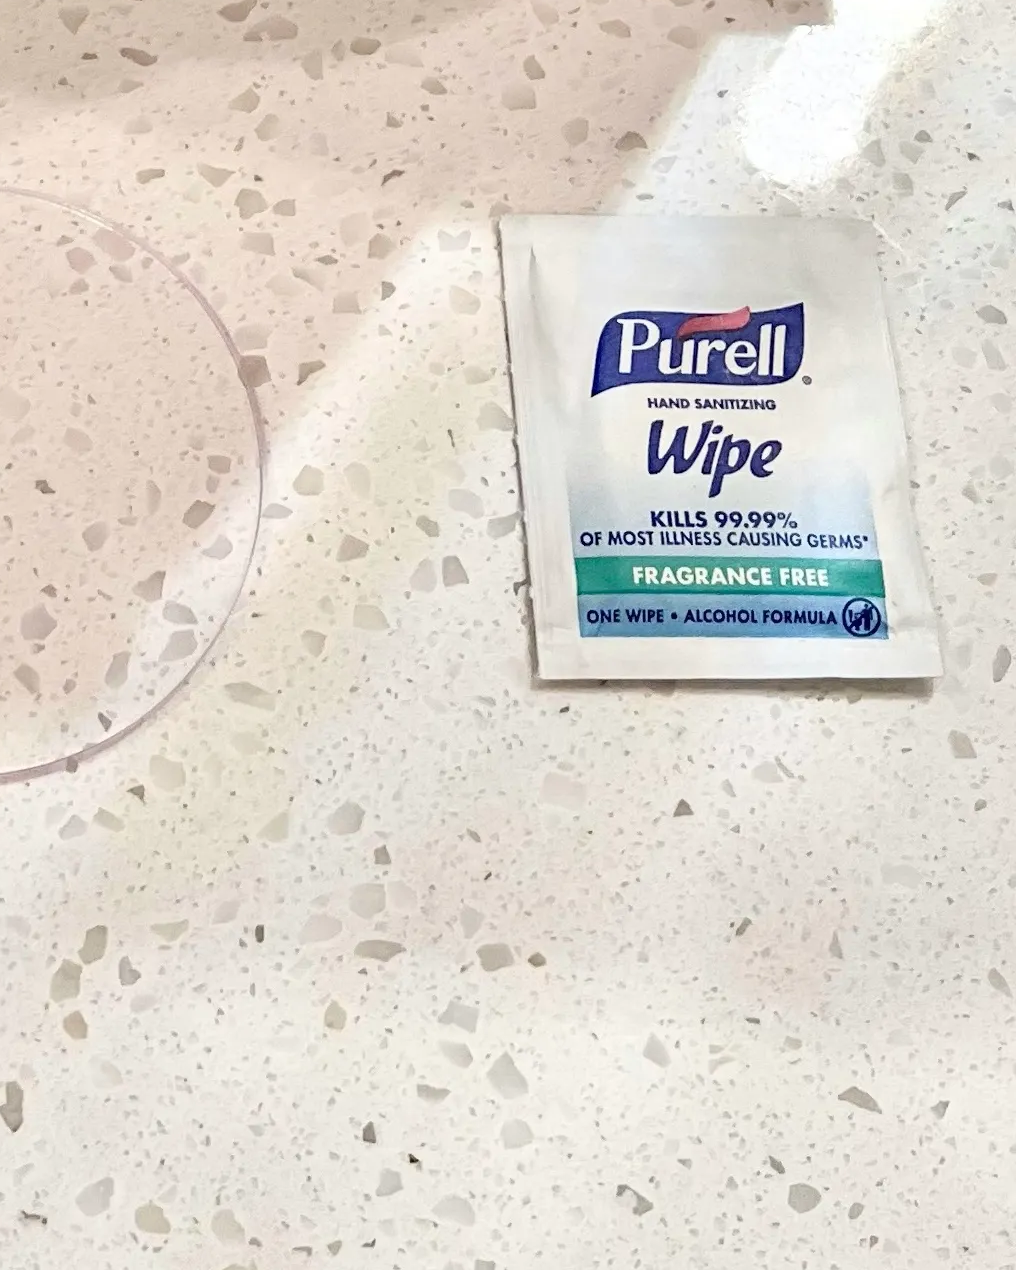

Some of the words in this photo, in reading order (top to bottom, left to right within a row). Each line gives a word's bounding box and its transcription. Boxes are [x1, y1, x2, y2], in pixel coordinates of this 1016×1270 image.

[616, 318, 786, 376] Purell
[647, 398, 690, 409] HAND
[695, 398, 776, 410] SANITIZING
[647, 419, 782, 498] Wipe
[651, 511, 707, 527] KILLS
[714, 511, 797, 528] 99.99%
[580, 532, 603, 547] OF
[608, 531, 653, 546] MOST
[660, 531, 722, 547] ILLNESS
[727, 532, 801, 547] CAUSING
[633, 566, 772, 585] FRAGRANCE
[779, 568, 829, 585] FREE
[587, 609, 621, 624] ONE
[626, 609, 664, 623] WIPE
[684, 609, 757, 624] ALCOHOL
[763, 610, 838, 625] FORMULA
